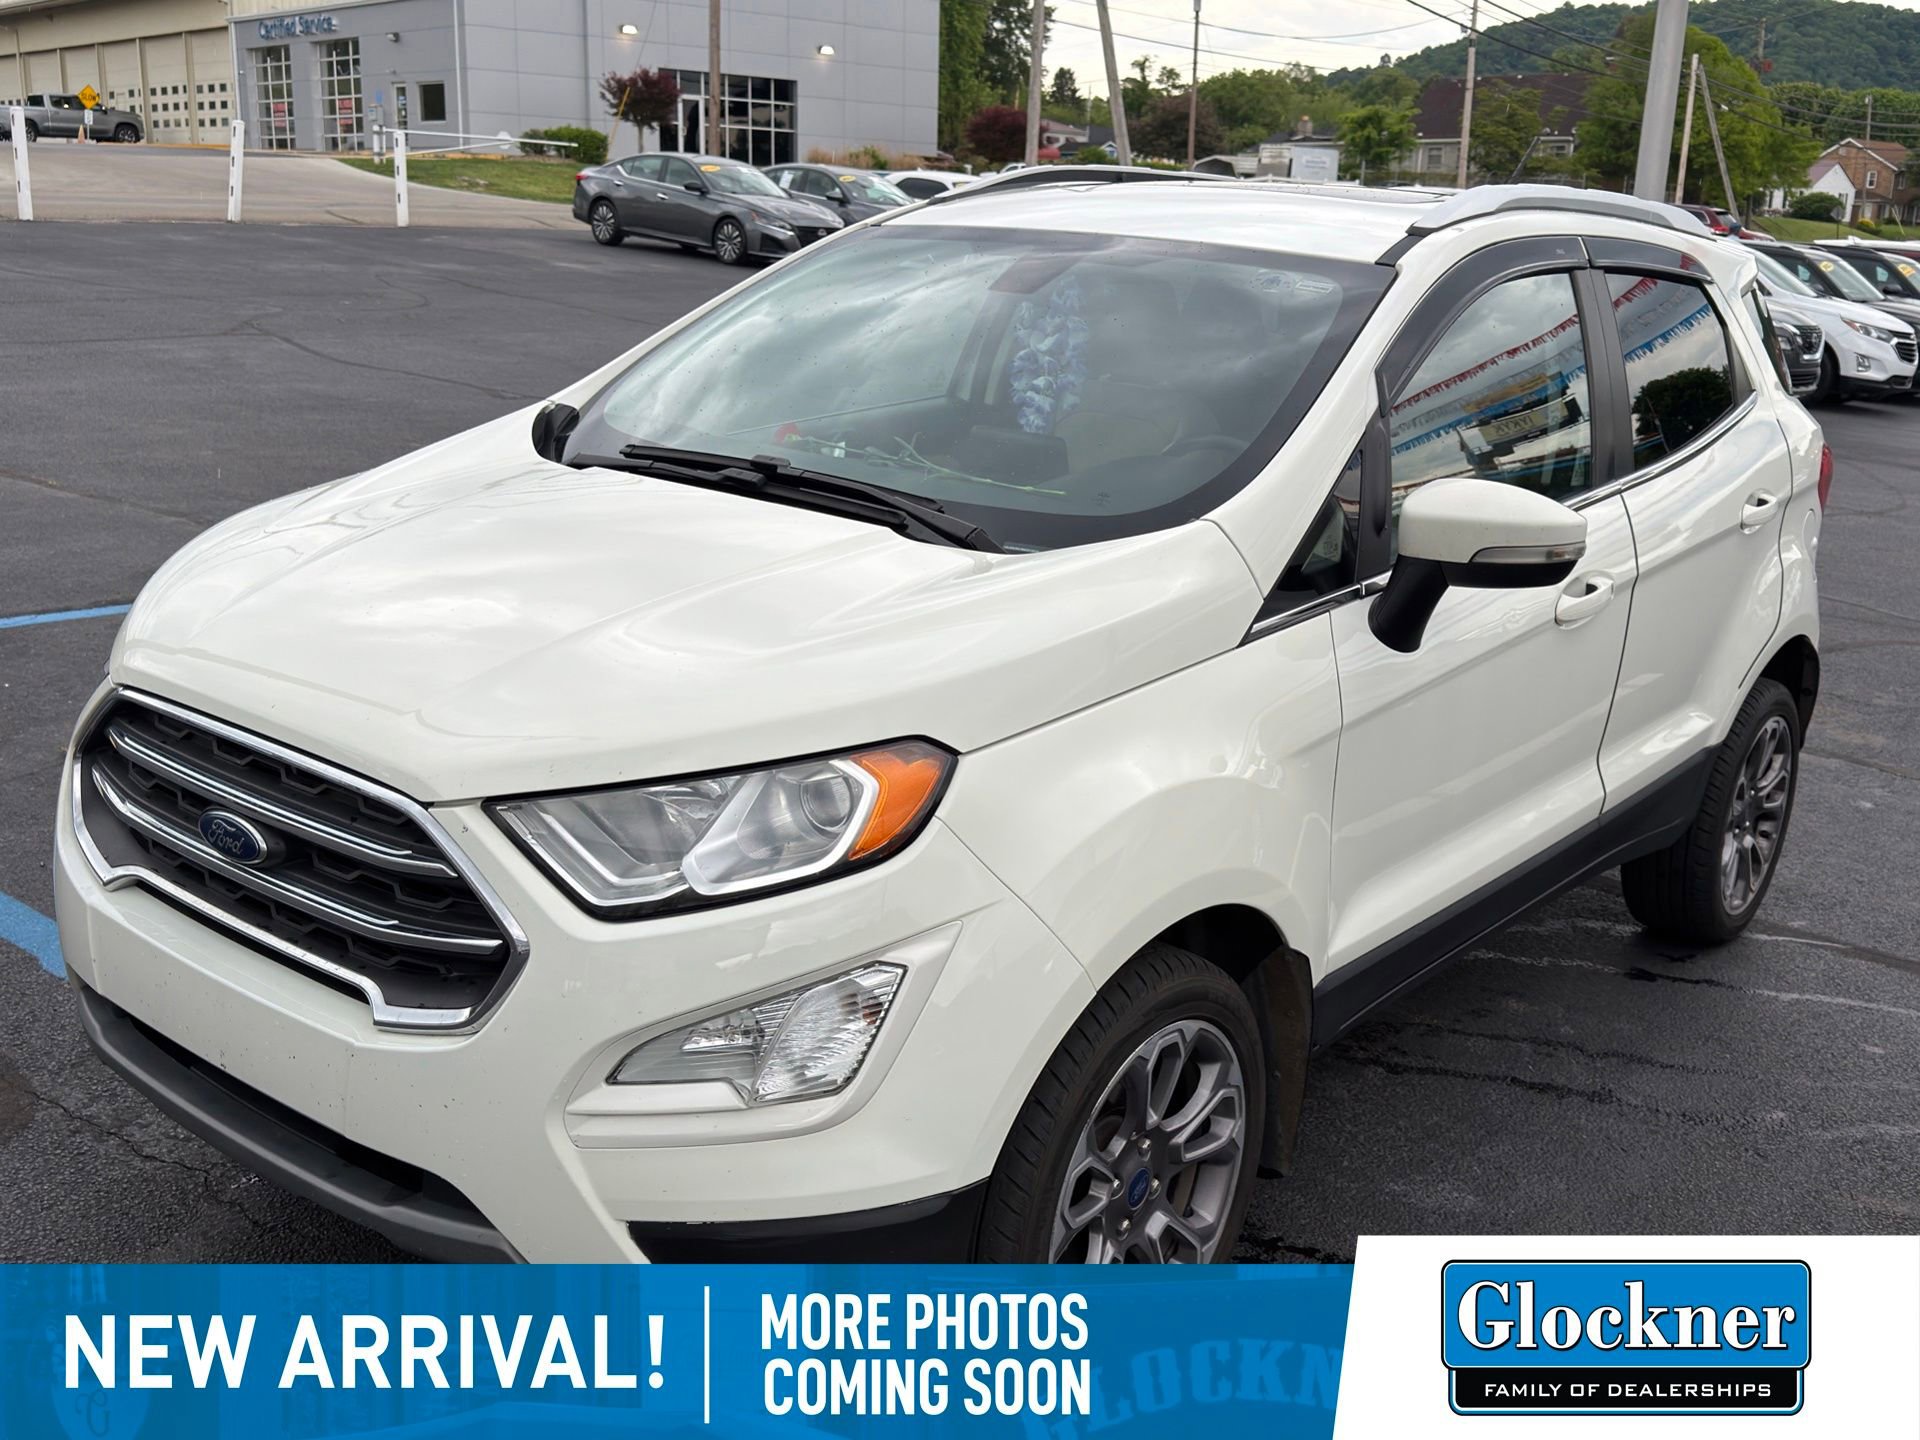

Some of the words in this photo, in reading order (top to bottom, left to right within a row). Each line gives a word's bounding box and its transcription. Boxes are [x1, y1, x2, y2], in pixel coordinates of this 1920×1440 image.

[258, 17, 297, 40] Certified
[299, 14, 335, 34] Service
[207, 819, 246, 854] Ford
